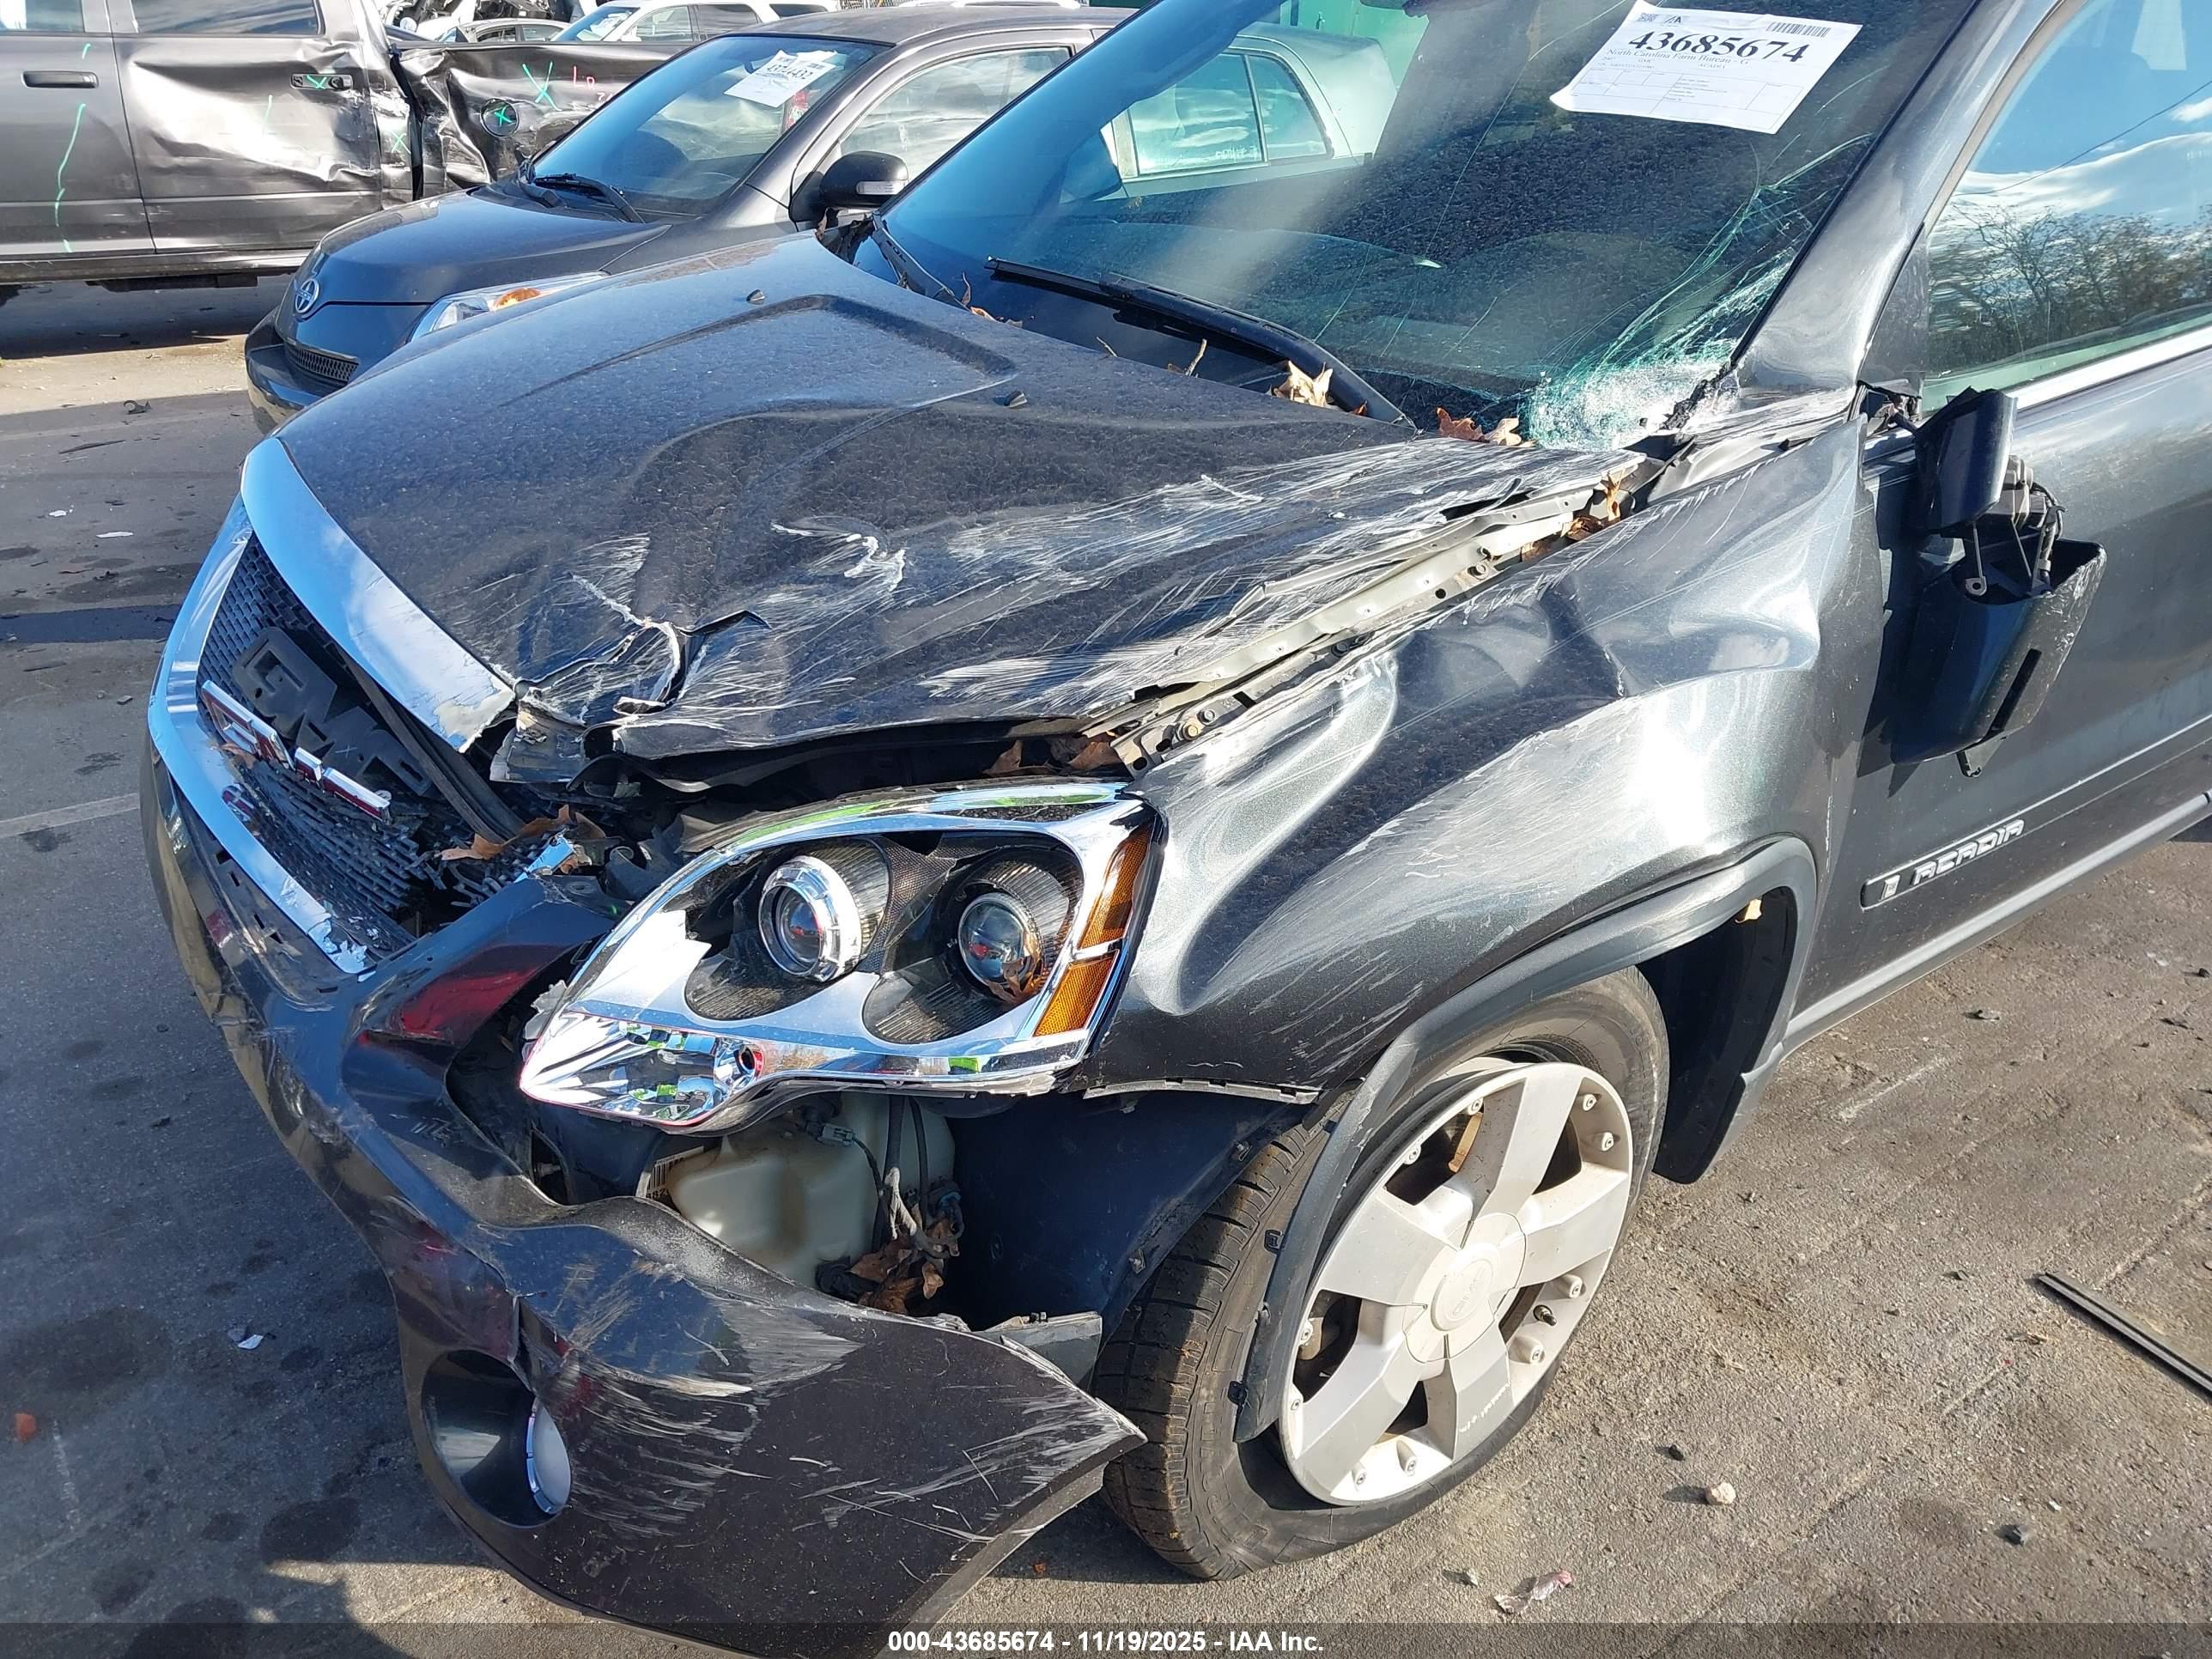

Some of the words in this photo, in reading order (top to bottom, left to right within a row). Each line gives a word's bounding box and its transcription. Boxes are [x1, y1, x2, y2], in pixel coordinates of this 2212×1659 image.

[1607, 48, 1632, 57] North
[1633, 50, 1671, 59] Carolina
[1628, 31, 1810, 62] 43685674
[1913, 819, 2025, 885] ACADIA
